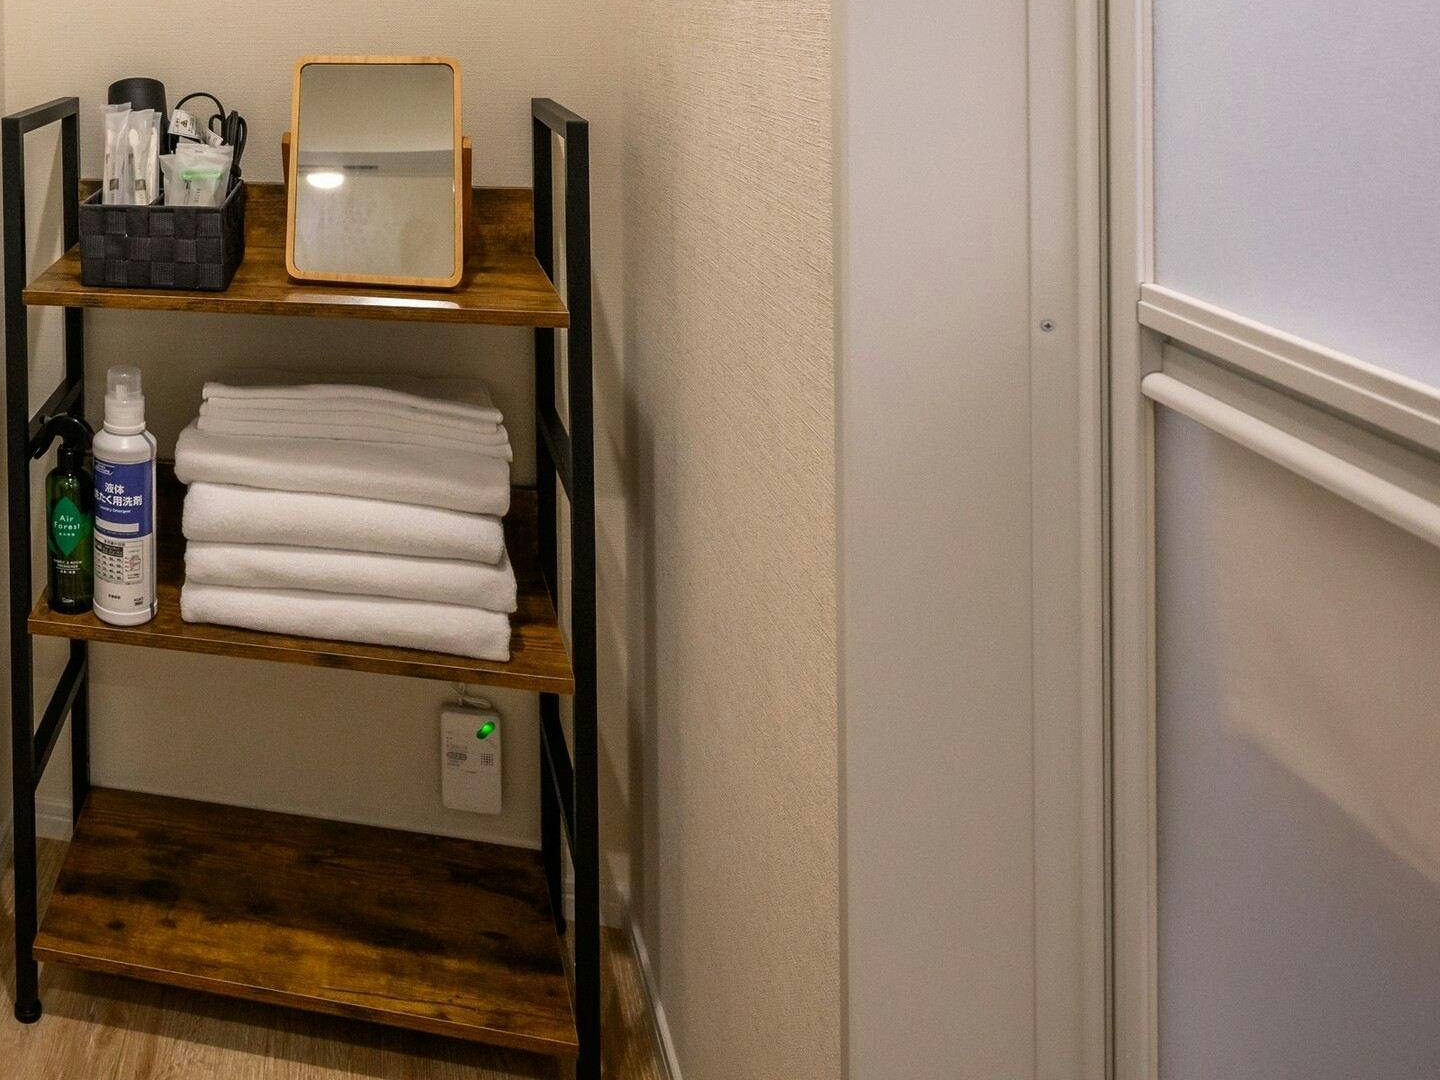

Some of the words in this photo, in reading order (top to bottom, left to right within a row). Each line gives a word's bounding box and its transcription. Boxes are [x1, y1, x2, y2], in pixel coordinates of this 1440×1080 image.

[104, 482, 125, 495] 液体
[59, 514, 74, 522] Air
[54, 521, 80, 530] Forest
